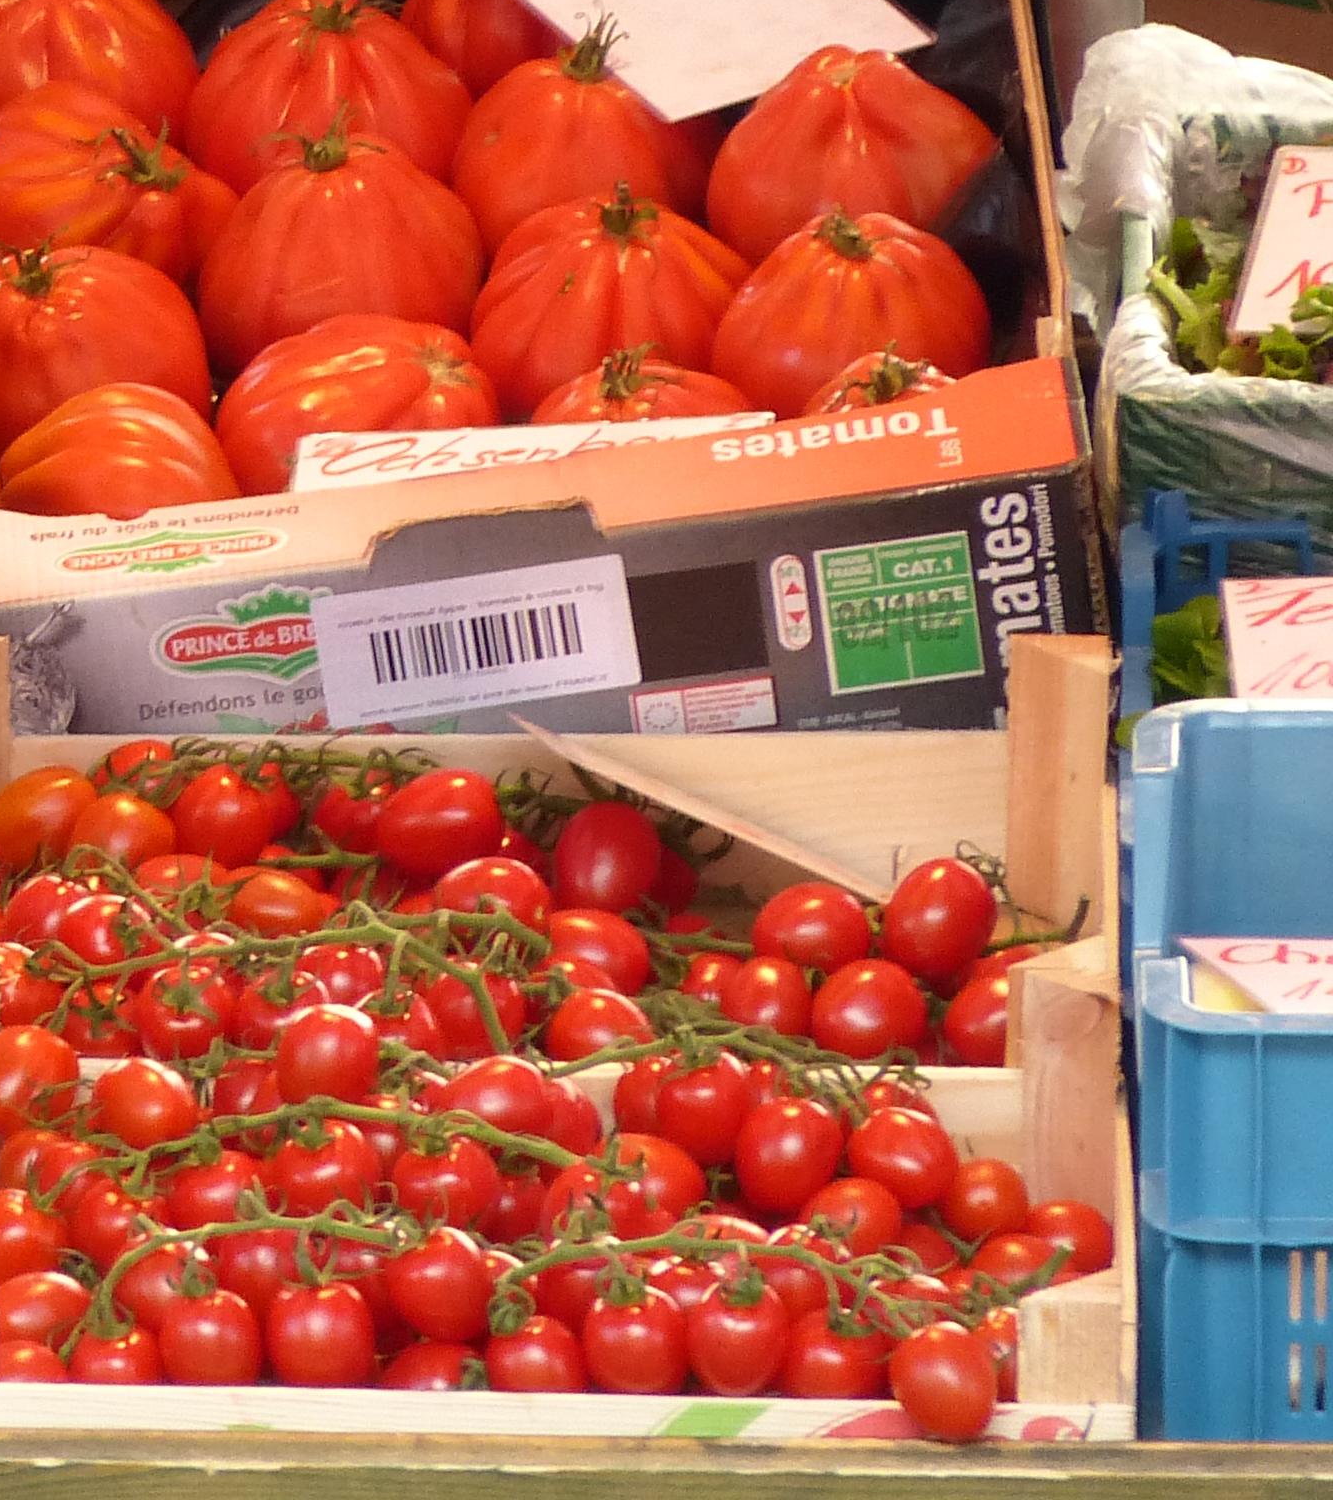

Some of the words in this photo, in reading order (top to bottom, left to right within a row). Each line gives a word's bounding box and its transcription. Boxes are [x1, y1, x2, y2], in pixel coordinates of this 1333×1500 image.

[710, 407, 960, 463] Tomates
[1029, 483, 1057, 559] Pomodori
[977, 491, 1043, 730] mates
[1044, 572, 1067, 635] matoes
[171, 631, 252, 658] PRINCE
[253, 631, 276, 648] de
[139, 692, 256, 722] Défendons
[264, 691, 285, 705] le
